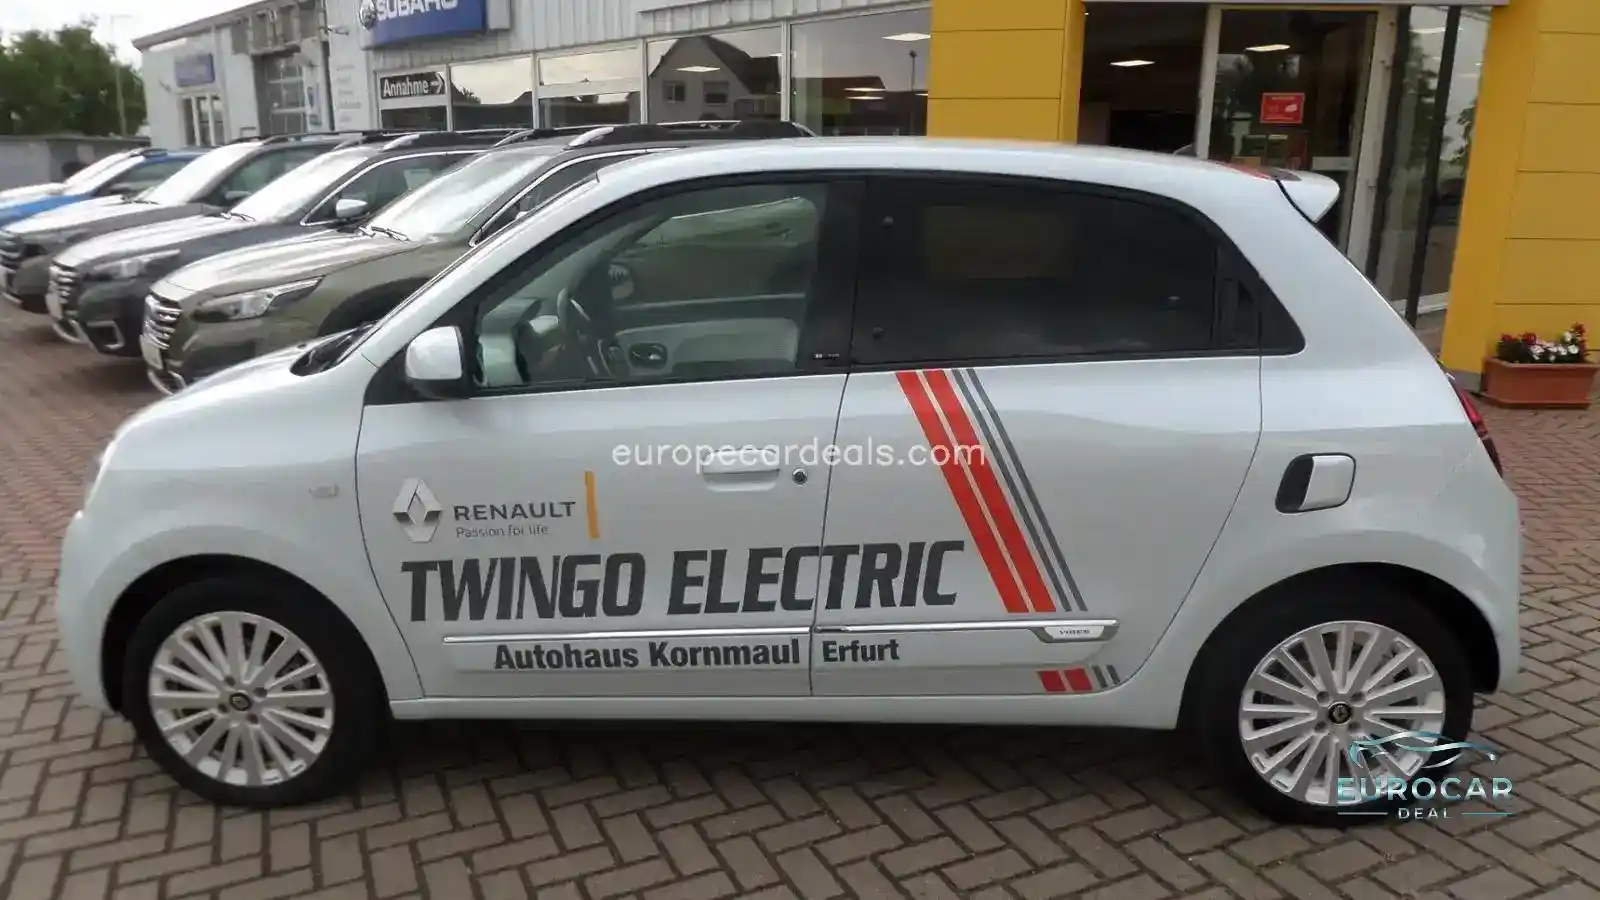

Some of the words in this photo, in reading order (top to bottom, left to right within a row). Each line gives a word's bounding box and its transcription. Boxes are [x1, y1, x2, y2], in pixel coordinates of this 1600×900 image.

[383, 76, 429, 97] Annahme
[453, 501, 576, 521] RENAULT
[456, 526, 504, 538] Passion
[508, 524, 524, 537] for
[529, 524, 549, 535] life
[400, 552, 646, 622] TWINGO
[666, 540, 964, 616] ELECTRIC
[494, 643, 639, 670] Autohaus
[649, 638, 800, 668] Kornmaul
[822, 638, 900, 663] Erfurt
